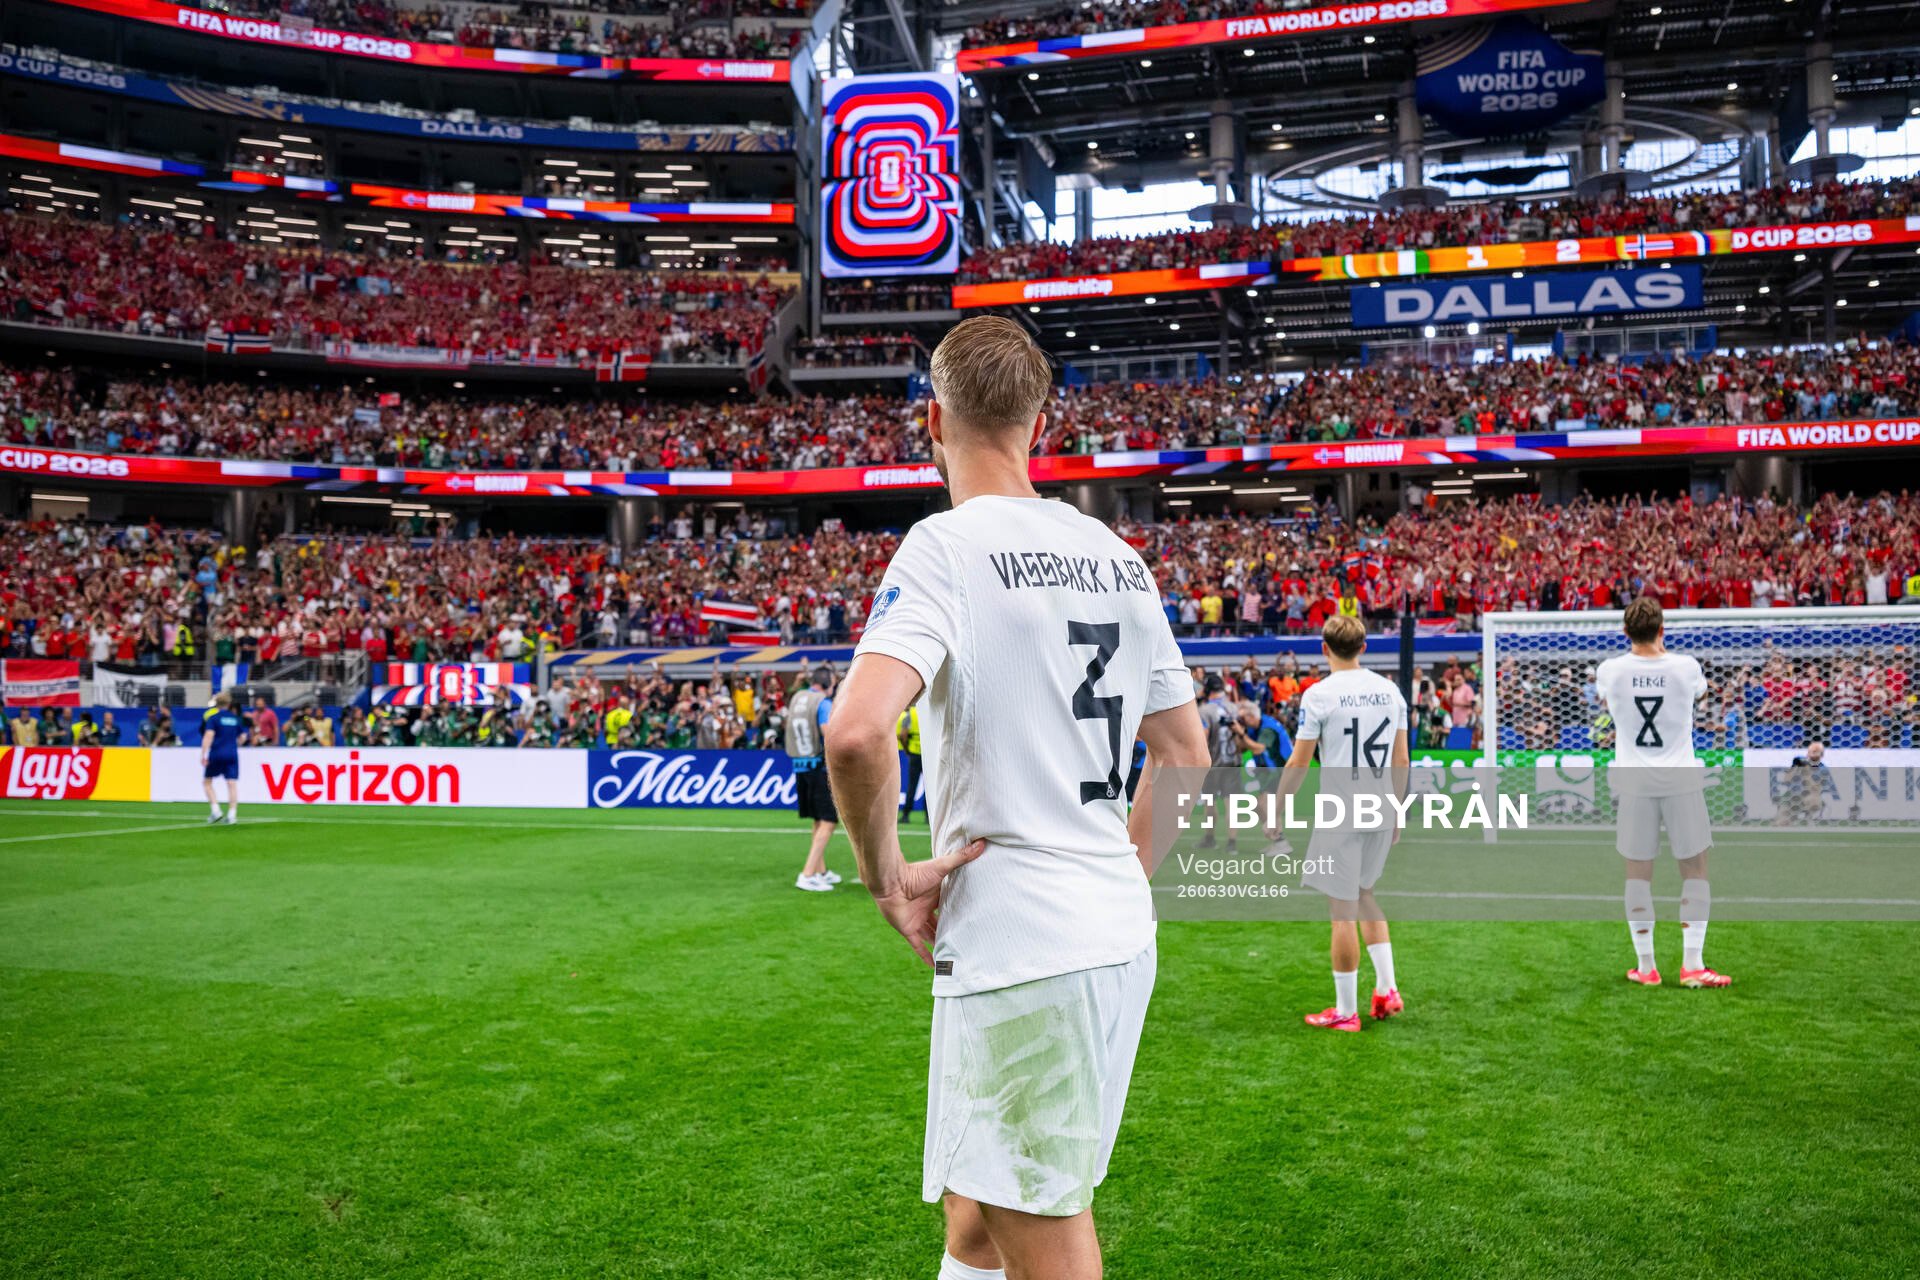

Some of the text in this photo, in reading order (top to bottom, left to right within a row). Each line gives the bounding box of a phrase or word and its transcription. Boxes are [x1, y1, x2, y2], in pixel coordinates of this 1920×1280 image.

[1226, 0, 1448, 37] FIFA WORLD CUP 2026
[178, 9, 412, 59] FIFA WORLD CUP 2026
[16, 58, 56, 75] CUP
[59, 66, 126, 88] 2026
[1498, 50, 1546, 70] FIFA
[1457, 68, 1586, 93] WORLD CUP
[1481, 92, 1559, 112] 2026
[421, 121, 523, 139] DALLAS
[1751, 229, 1794, 247] CUP
[1796, 223, 1873, 245] 2026
[1467, 240, 1581, 268] 1 2
[1384, 272, 1686, 323] DALLAS
[1737, 422, 1920, 447] FIFA WORLD CUP
[0, 449, 129, 476] CUP 2026
[989, 552, 1108, 593] VASSBAKK
[1632, 676, 1666, 688] BERGE
[1068, 620, 1123, 805] 3
[1634, 696, 1664, 747] 8
[1343, 716, 1391, 780] 16
[6, 746, 91, 800] Lay's
[261, 751, 460, 805] verizon
